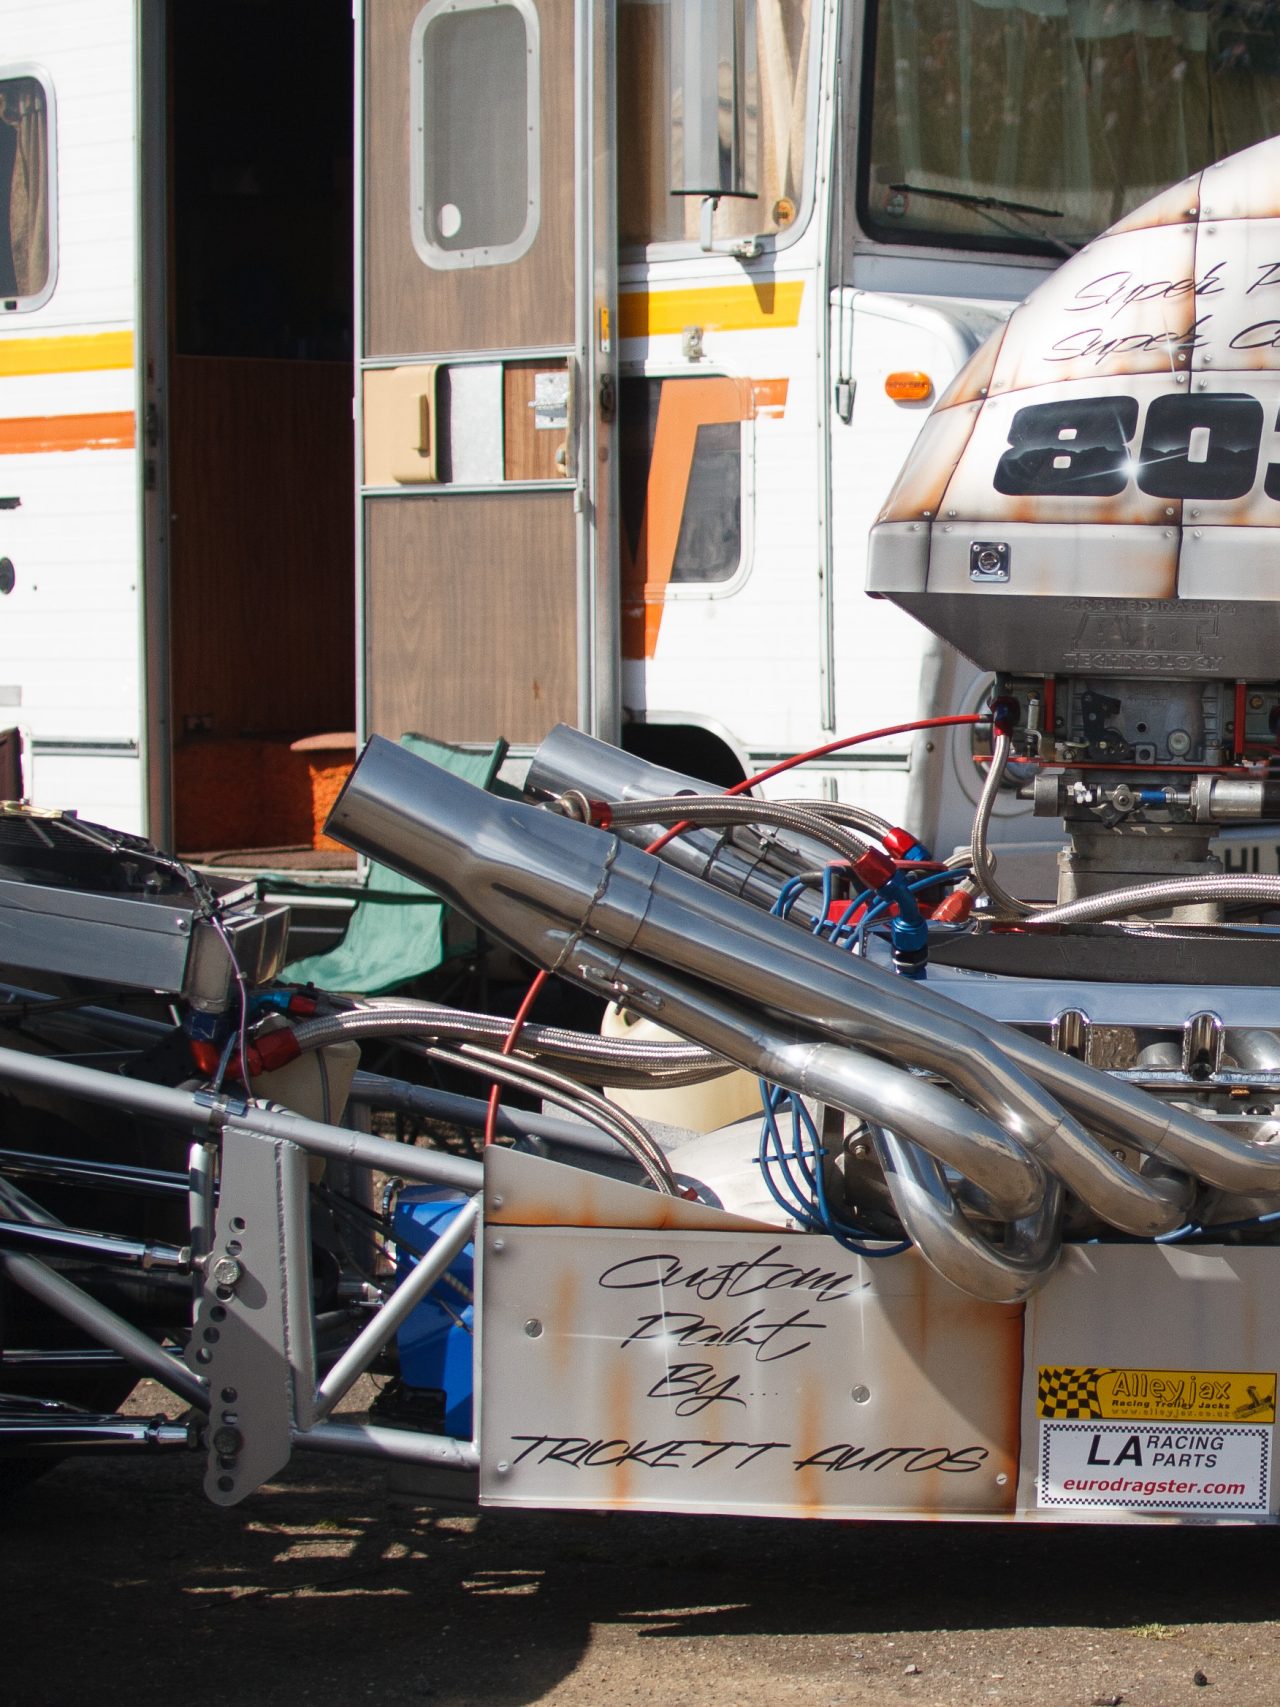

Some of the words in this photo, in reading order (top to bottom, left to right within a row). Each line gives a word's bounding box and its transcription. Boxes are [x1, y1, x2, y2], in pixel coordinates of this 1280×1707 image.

[1064, 261, 1227, 319] Super
[1043, 314, 1213, 365] Super
[598, 1244, 872, 1302] Custom
[620, 1308, 827, 1362] Paint
[1111, 1371, 1233, 1408] Alleyjax
[1111, 1399, 1150, 1409] Racing
[1198, 1401, 1231, 1410] Jacks
[510, 1434, 791, 1473] TRICKETT
[793, 1443, 990, 1474] AUTOS
[1086, 1433, 1144, 1467] LA
[1146, 1435, 1225, 1451] RACING
[1152, 1453, 1218, 1468] PARTS
[1062, 1476, 1246, 1496] eurodragster.com
